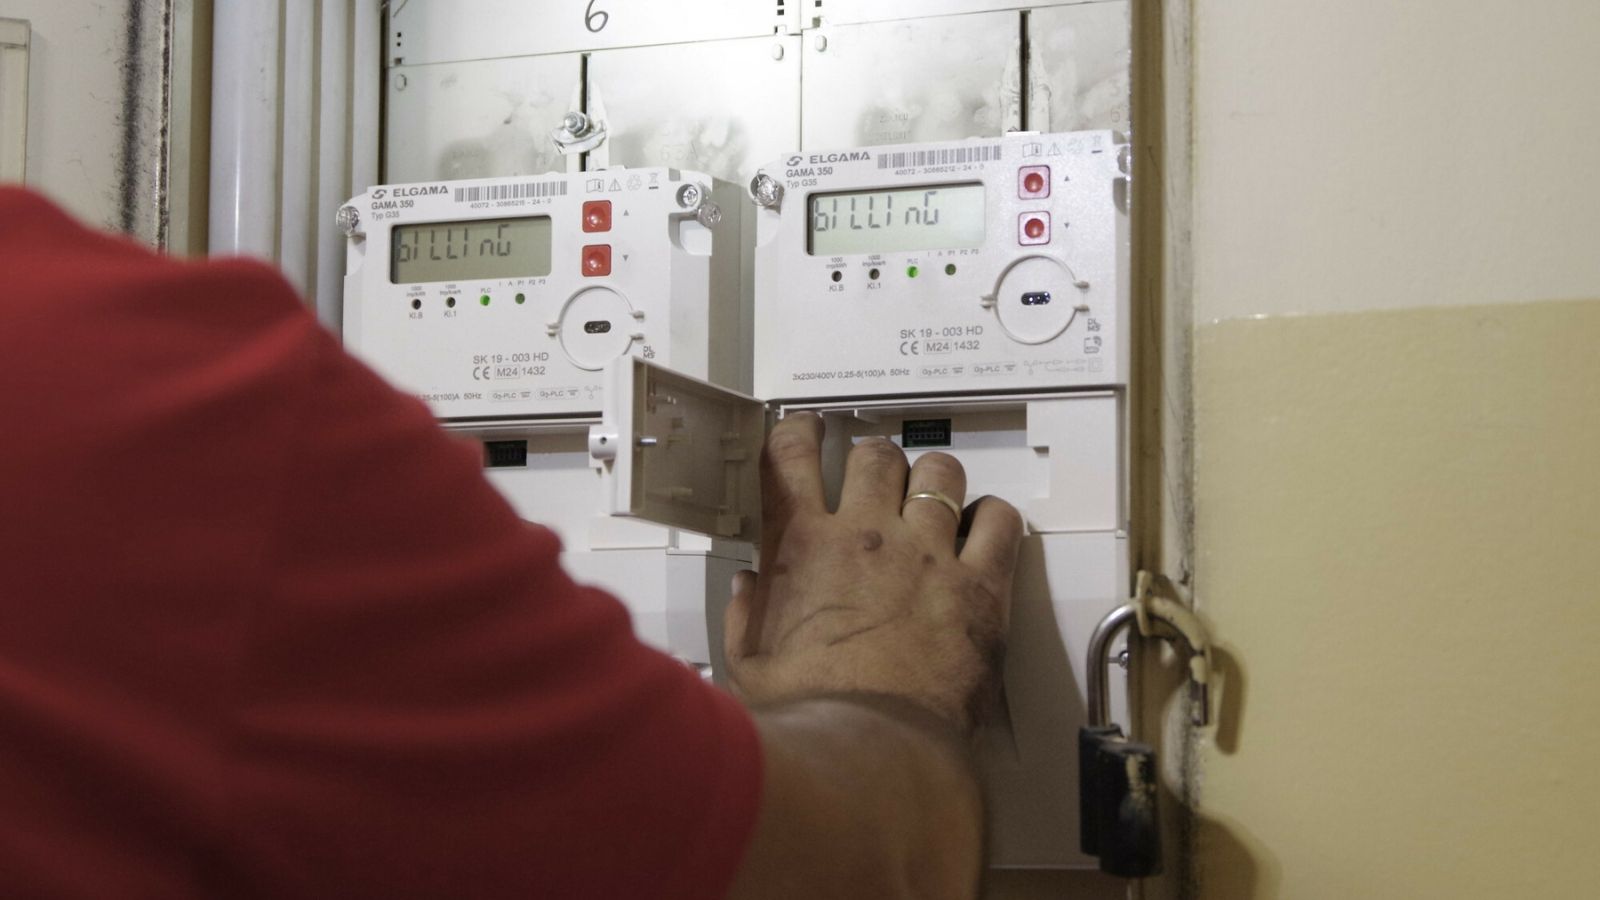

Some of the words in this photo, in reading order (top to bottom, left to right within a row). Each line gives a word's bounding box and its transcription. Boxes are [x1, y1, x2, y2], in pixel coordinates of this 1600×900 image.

[584, 0, 608, 33] 6
[809, 151, 871, 164] ELGAMA
[786, 168, 815, 178] GAMA
[817, 166, 833, 176] 350
[786, 180, 800, 188] Typ
[801, 178, 818, 187] G35
[393, 185, 449, 198] ELGAMA
[371, 200, 398, 211] GAMA
[399, 199, 414, 209] 350
[371, 212, 384, 221] Typ
[385, 211, 400, 219] G35
[899, 329, 916, 339] SK
[920, 328, 933, 338] 19
[942, 327, 962, 337] 003
[966, 326, 984, 336] HD
[926, 342, 950, 353] M24
[953, 340, 980, 351] 1432
[473, 354, 488, 365] SK
[491, 354, 503, 364] 19
[511, 353, 531, 363] 003
[533, 352, 549, 362] HD
[496, 366, 518, 378] M24
[521, 365, 546, 377] 1432
[889, 367, 911, 376] 50Hz
[463, 391, 482, 401] 50Hz
